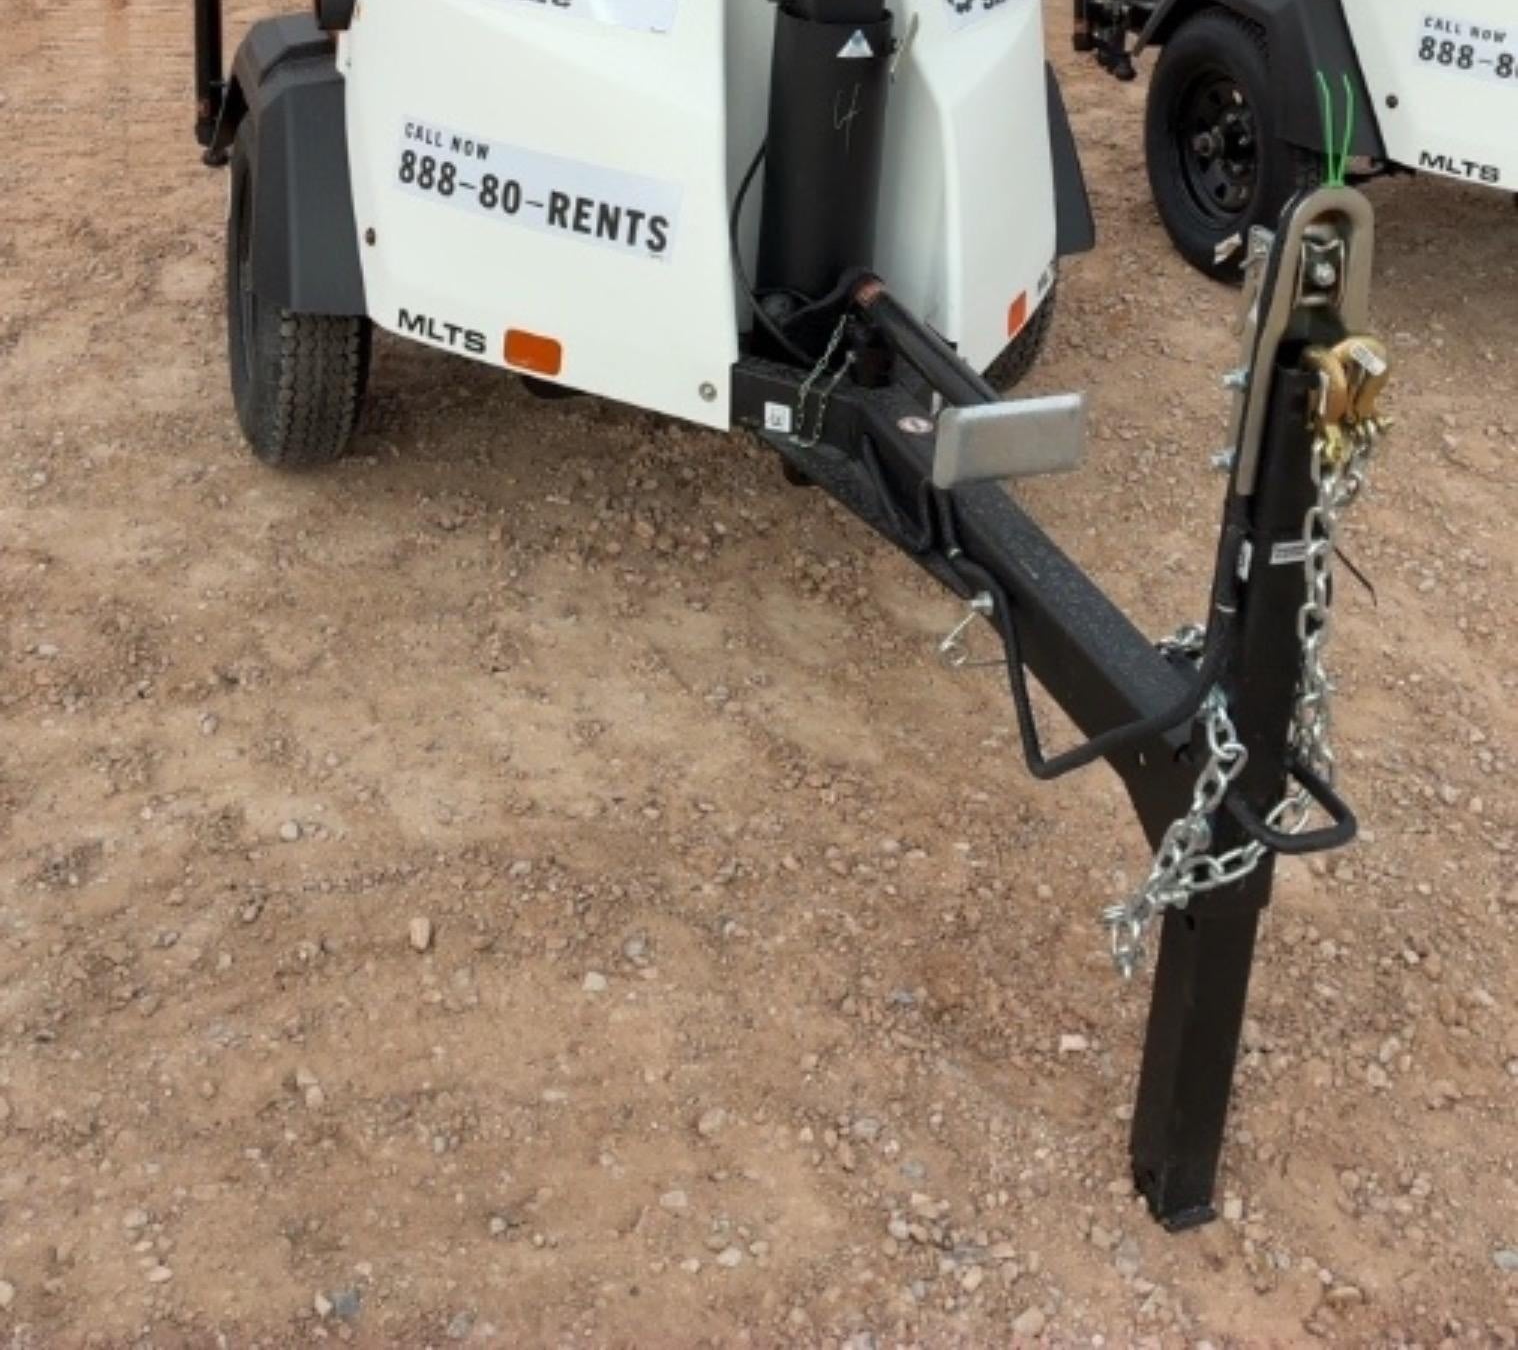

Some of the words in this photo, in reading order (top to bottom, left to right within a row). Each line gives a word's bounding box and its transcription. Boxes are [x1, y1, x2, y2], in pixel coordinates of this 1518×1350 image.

[1424, 16, 1461, 36] CALL
[1469, 26, 1507, 43] NOW
[1418, 35, 1518, 79] 888-8
[404, 121, 443, 148] CALL
[450, 134, 490, 160] NOW
[1419, 150, 1500, 183] MLTS
[398, 149, 670, 253] 888-80-RENTS
[398, 308, 487, 354] MLTS
